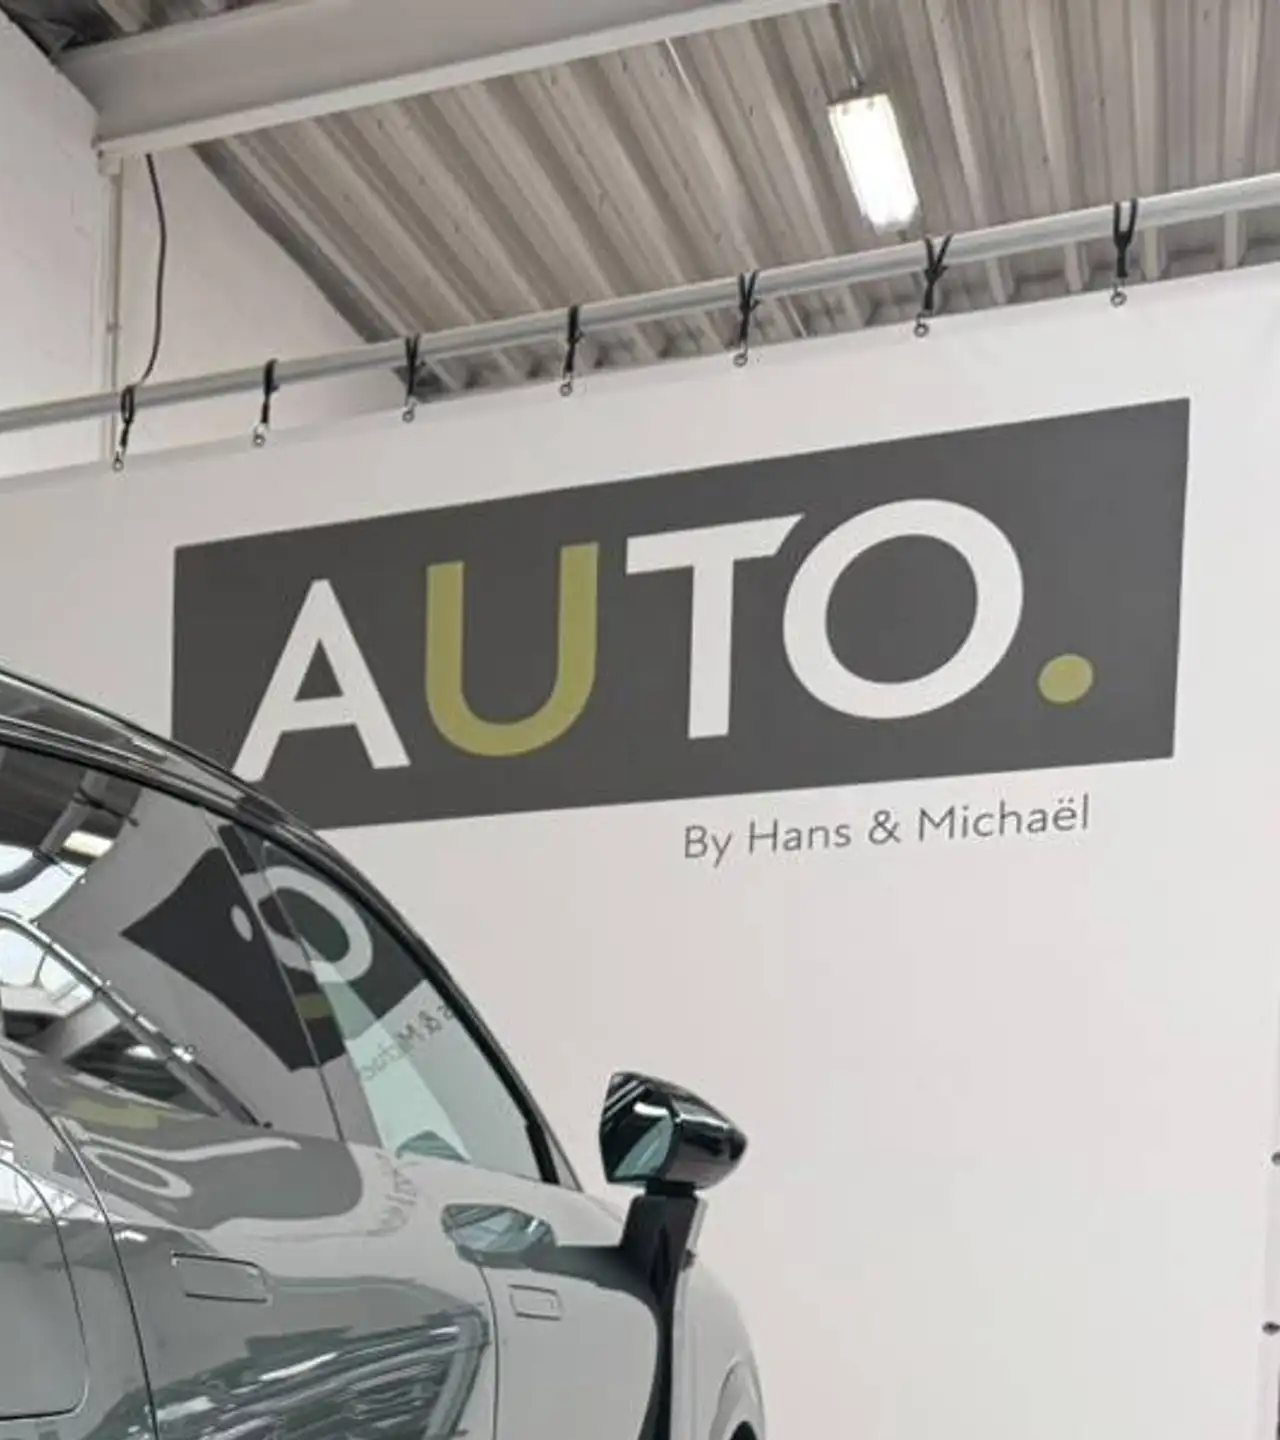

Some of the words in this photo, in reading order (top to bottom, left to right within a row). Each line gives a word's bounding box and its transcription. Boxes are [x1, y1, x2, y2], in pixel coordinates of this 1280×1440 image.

[683, 824, 734, 868] By
[748, 818, 852, 855] Hans
[868, 810, 901, 847] &
[918, 793, 1090, 841] Michaël
